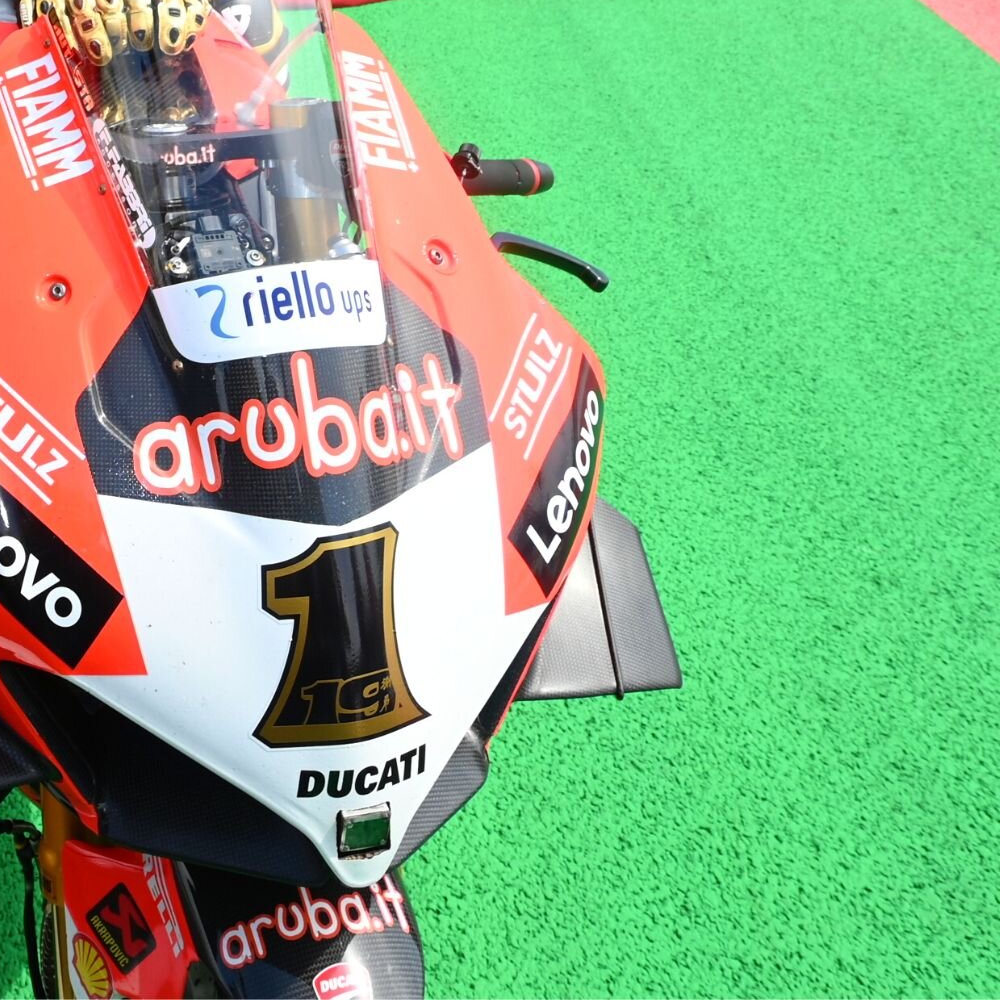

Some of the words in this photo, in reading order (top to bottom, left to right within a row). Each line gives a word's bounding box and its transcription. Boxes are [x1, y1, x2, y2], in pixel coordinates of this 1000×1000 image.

[5, 52, 95, 188] FIAMM
[161, 144, 216, 166] uba.it
[341, 50, 408, 172] FIAMM
[242, 270, 335, 327] riello
[341, 288, 372, 322] ups
[133, 350, 464, 496] aruba.it
[503, 327, 563, 440] STULZ
[526, 390, 600, 564] Lenovo
[252, 521, 432, 749] 1
[297, 743, 426, 799] DUCATI
[142, 853, 184, 959] RELLI
[219, 872, 411, 969] aruba.it
